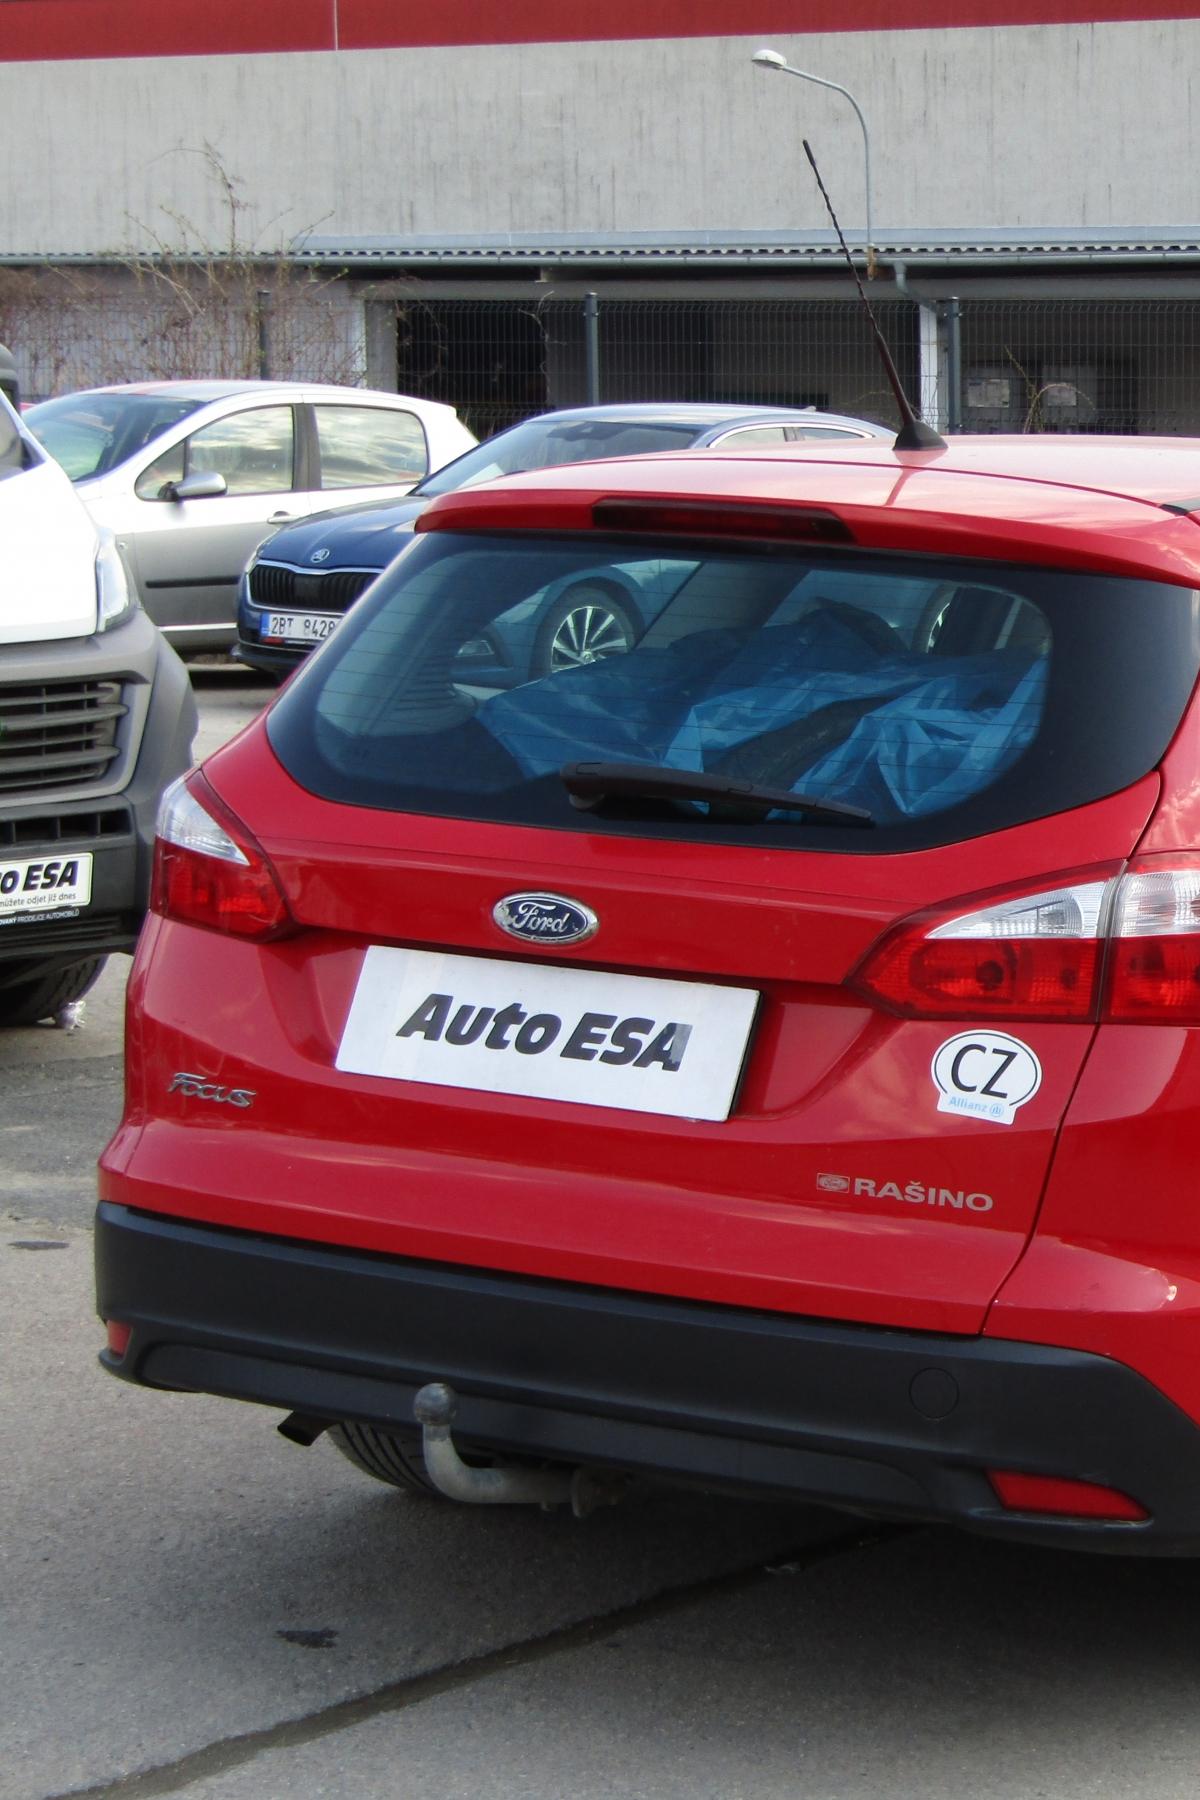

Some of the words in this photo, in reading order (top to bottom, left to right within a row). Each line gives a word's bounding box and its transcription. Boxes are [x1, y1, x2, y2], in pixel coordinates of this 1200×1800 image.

[271, 616, 294, 635] 2BT
[22, 861, 79, 891] ESA
[58, 892, 76, 902] dnes
[512, 901, 571, 933] Ford
[395, 992, 562, 1055] Auto
[559, 1011, 693, 1072] ESA
[951, 1043, 1018, 1099] CZ
[167, 1072, 257, 1108] Focus
[948, 1095, 988, 1114] Allianz
[854, 1177, 994, 1212] RAŠINO
